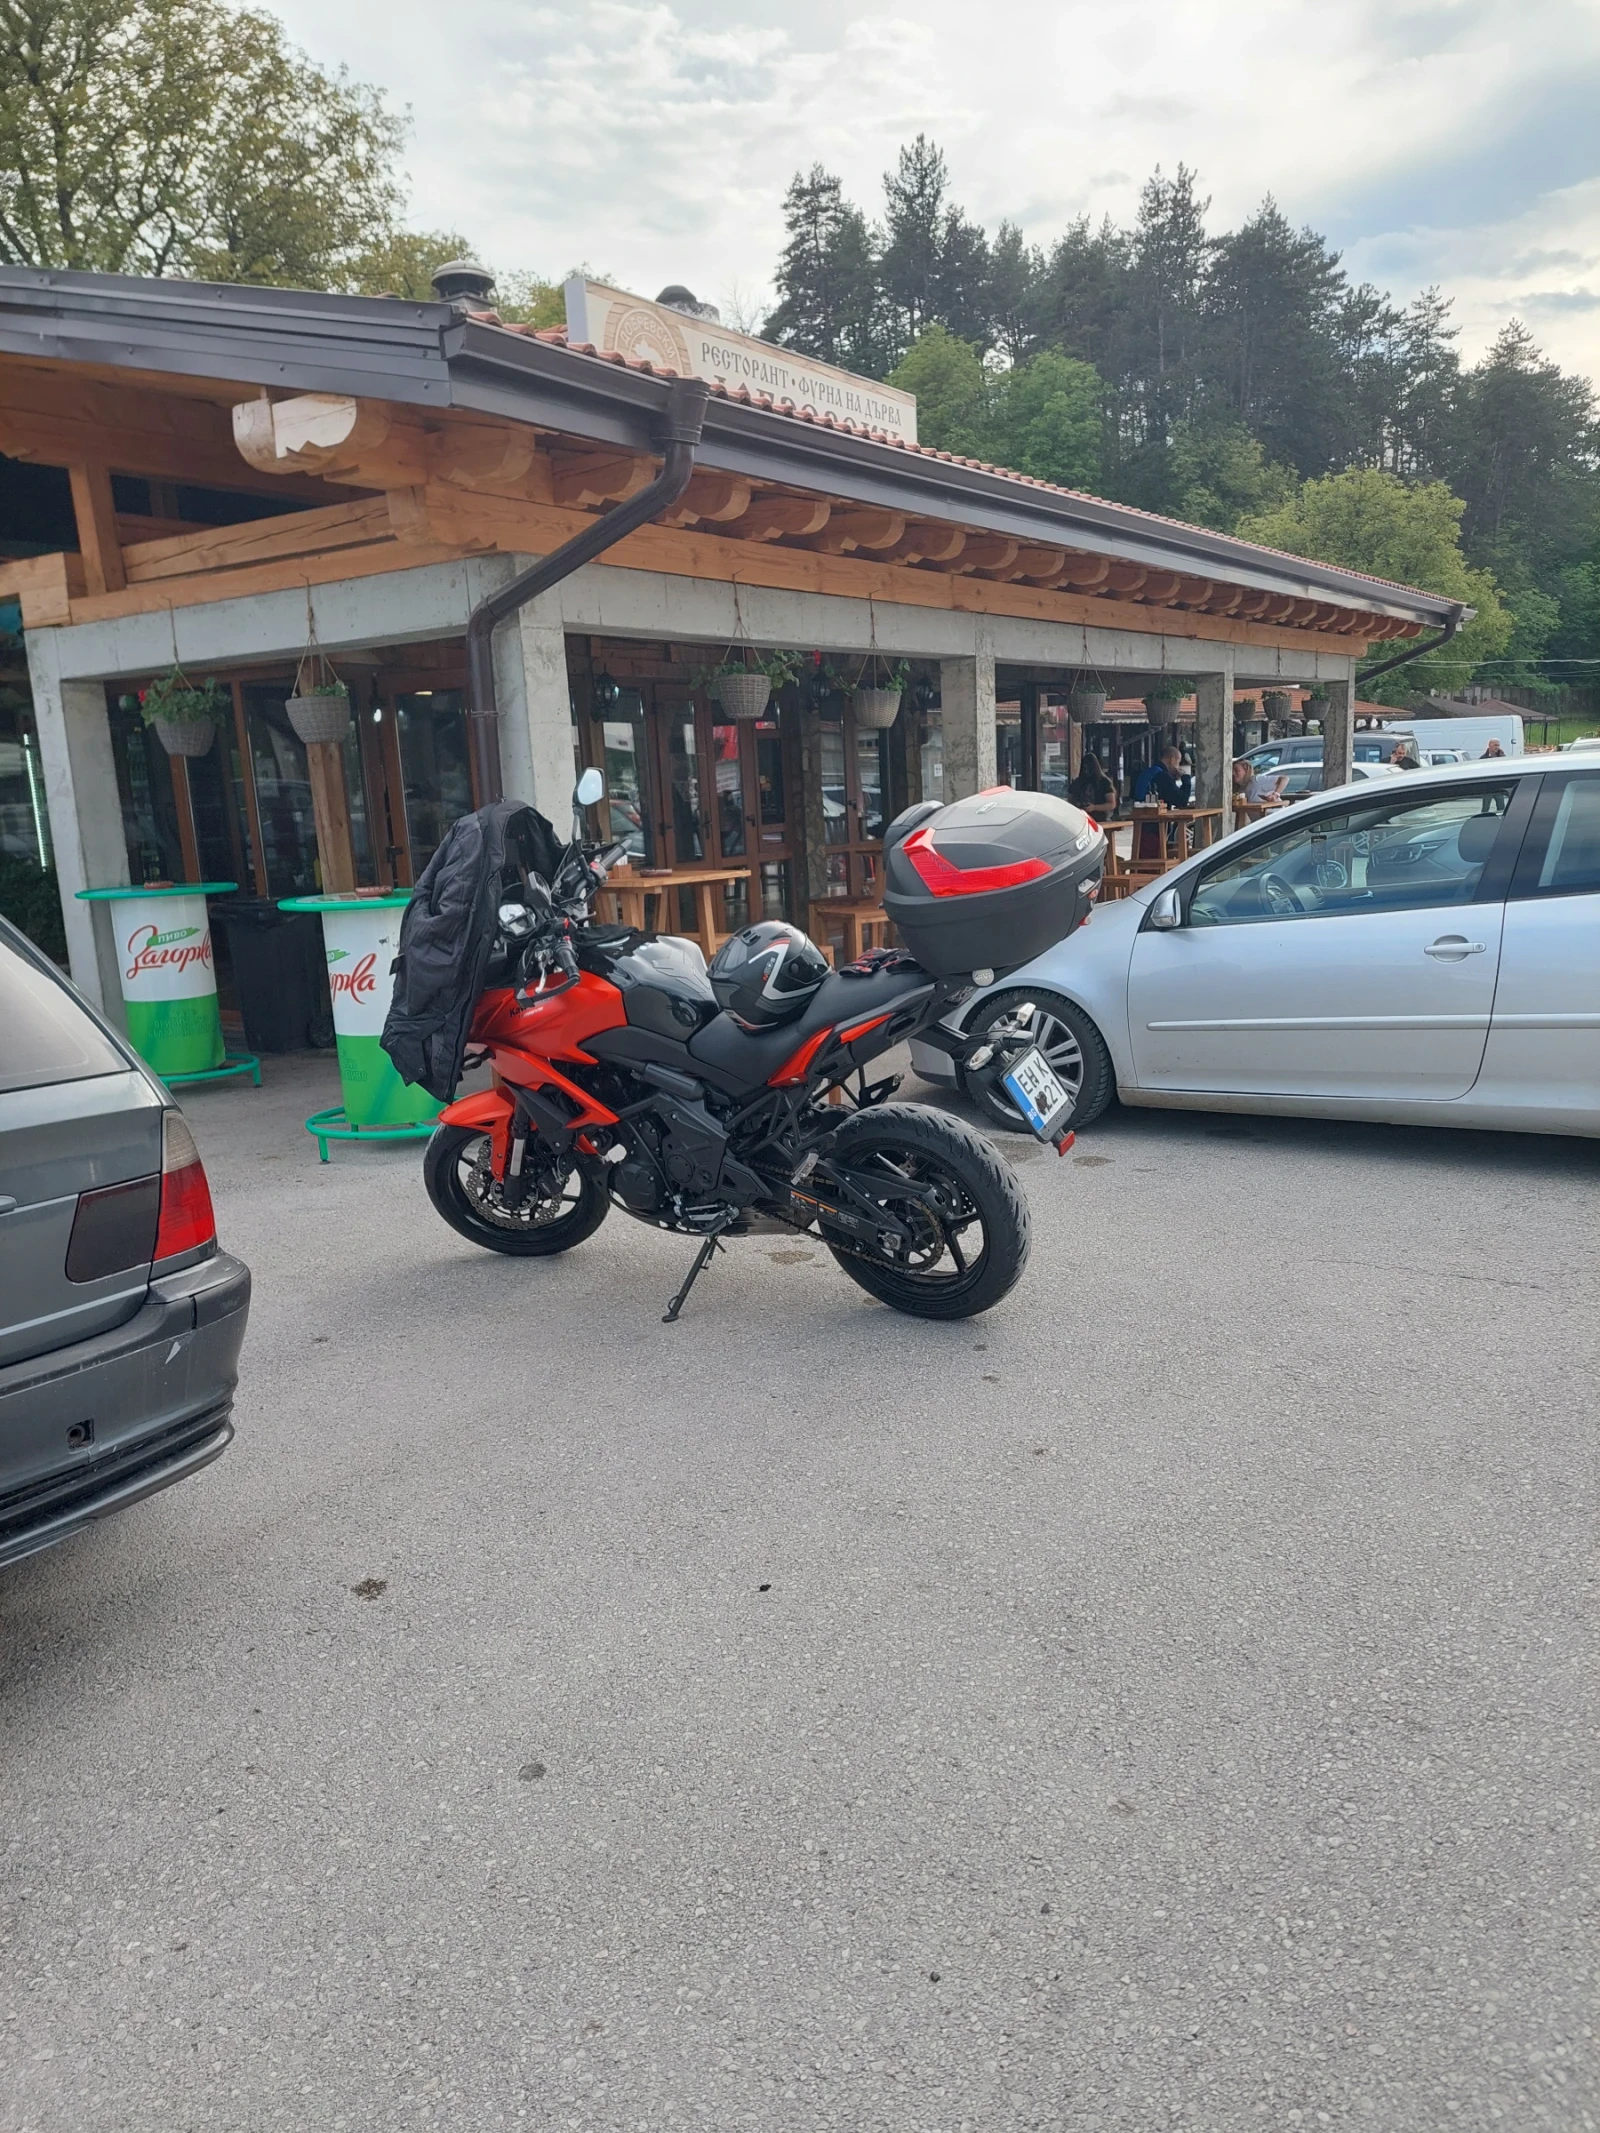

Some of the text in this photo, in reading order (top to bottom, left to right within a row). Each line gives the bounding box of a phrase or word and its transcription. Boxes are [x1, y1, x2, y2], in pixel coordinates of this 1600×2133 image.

[620, 317, 676, 359] ДОБРЕВСКИ
[798, 376, 843, 407] ФУРНА
[845, 391, 862, 413] НА
[864, 400, 902, 427] ДЪРВА
[1027, 1108, 1038, 1120] BG
